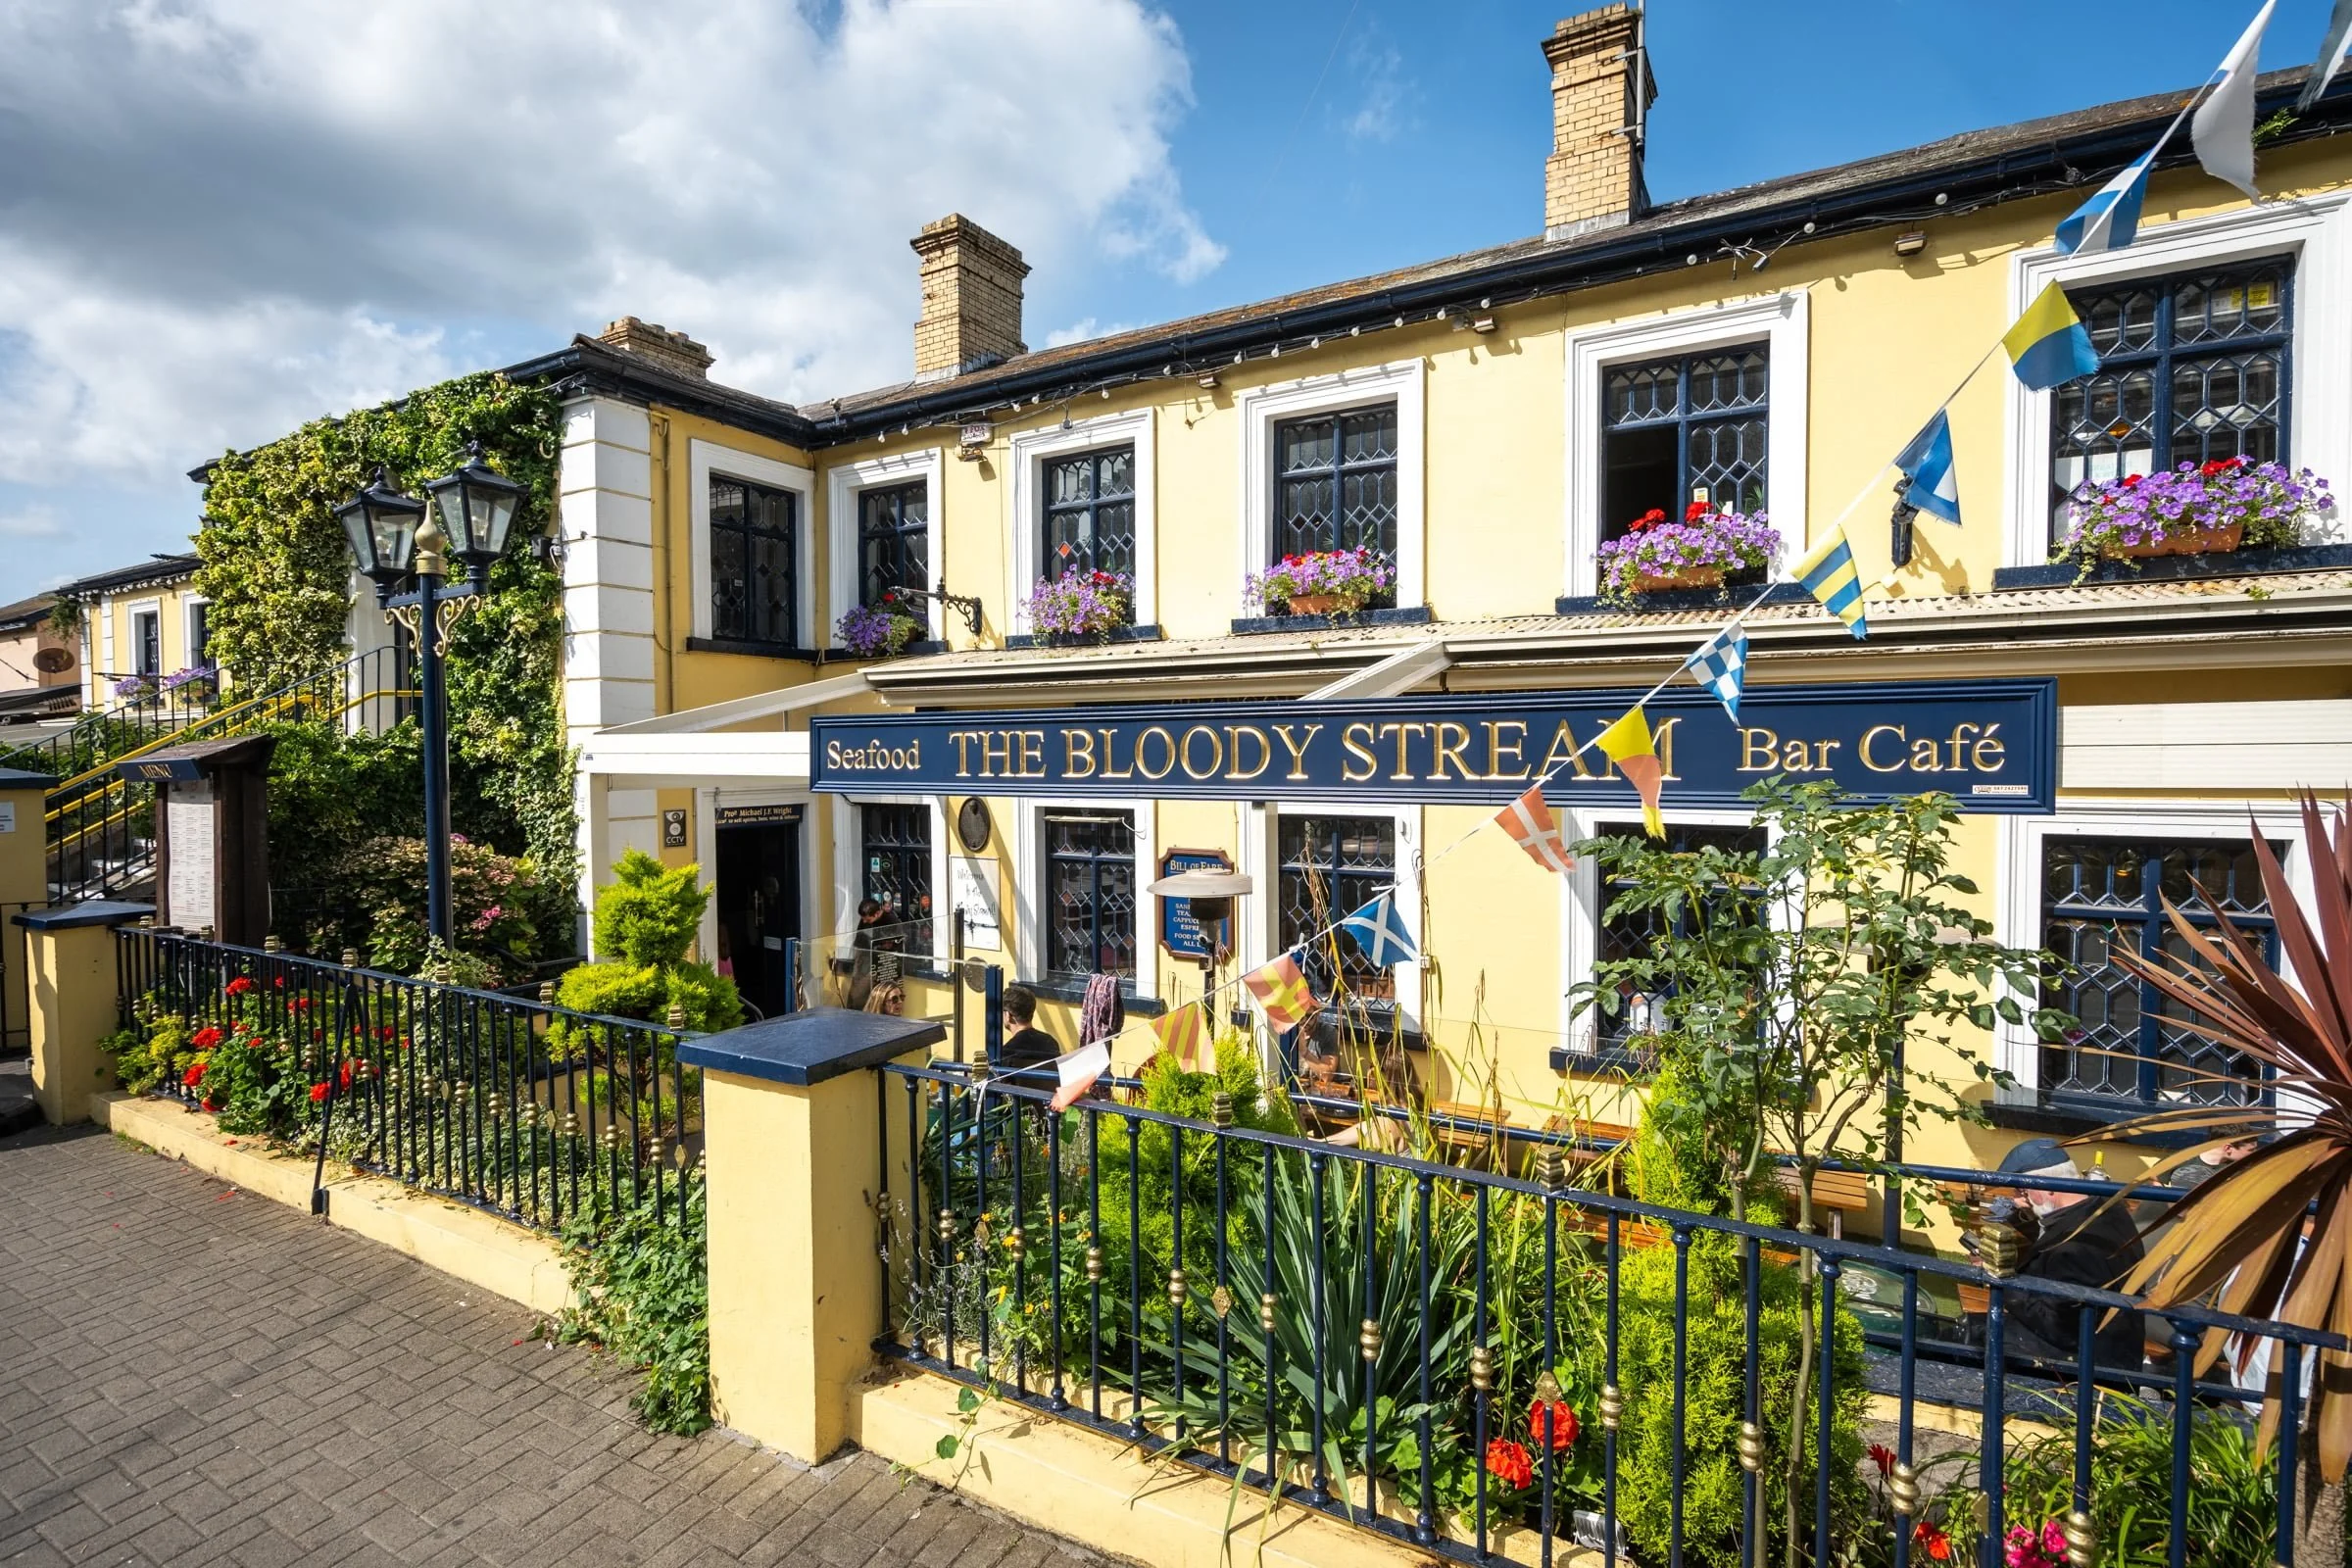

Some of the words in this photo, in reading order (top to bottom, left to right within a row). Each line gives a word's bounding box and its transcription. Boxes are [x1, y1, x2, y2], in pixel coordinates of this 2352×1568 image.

[826, 738, 921, 770] Seafood
[949, 730, 1047, 778] THE
[1059, 724, 1324, 780] BLOODY
[1341, 717, 1683, 782] STREAM
[1736, 725, 1841, 772] Bar
[1858, 721, 2006, 773] Café
[138, 763, 172, 778] MENU
[740, 808, 761, 816] Michael
